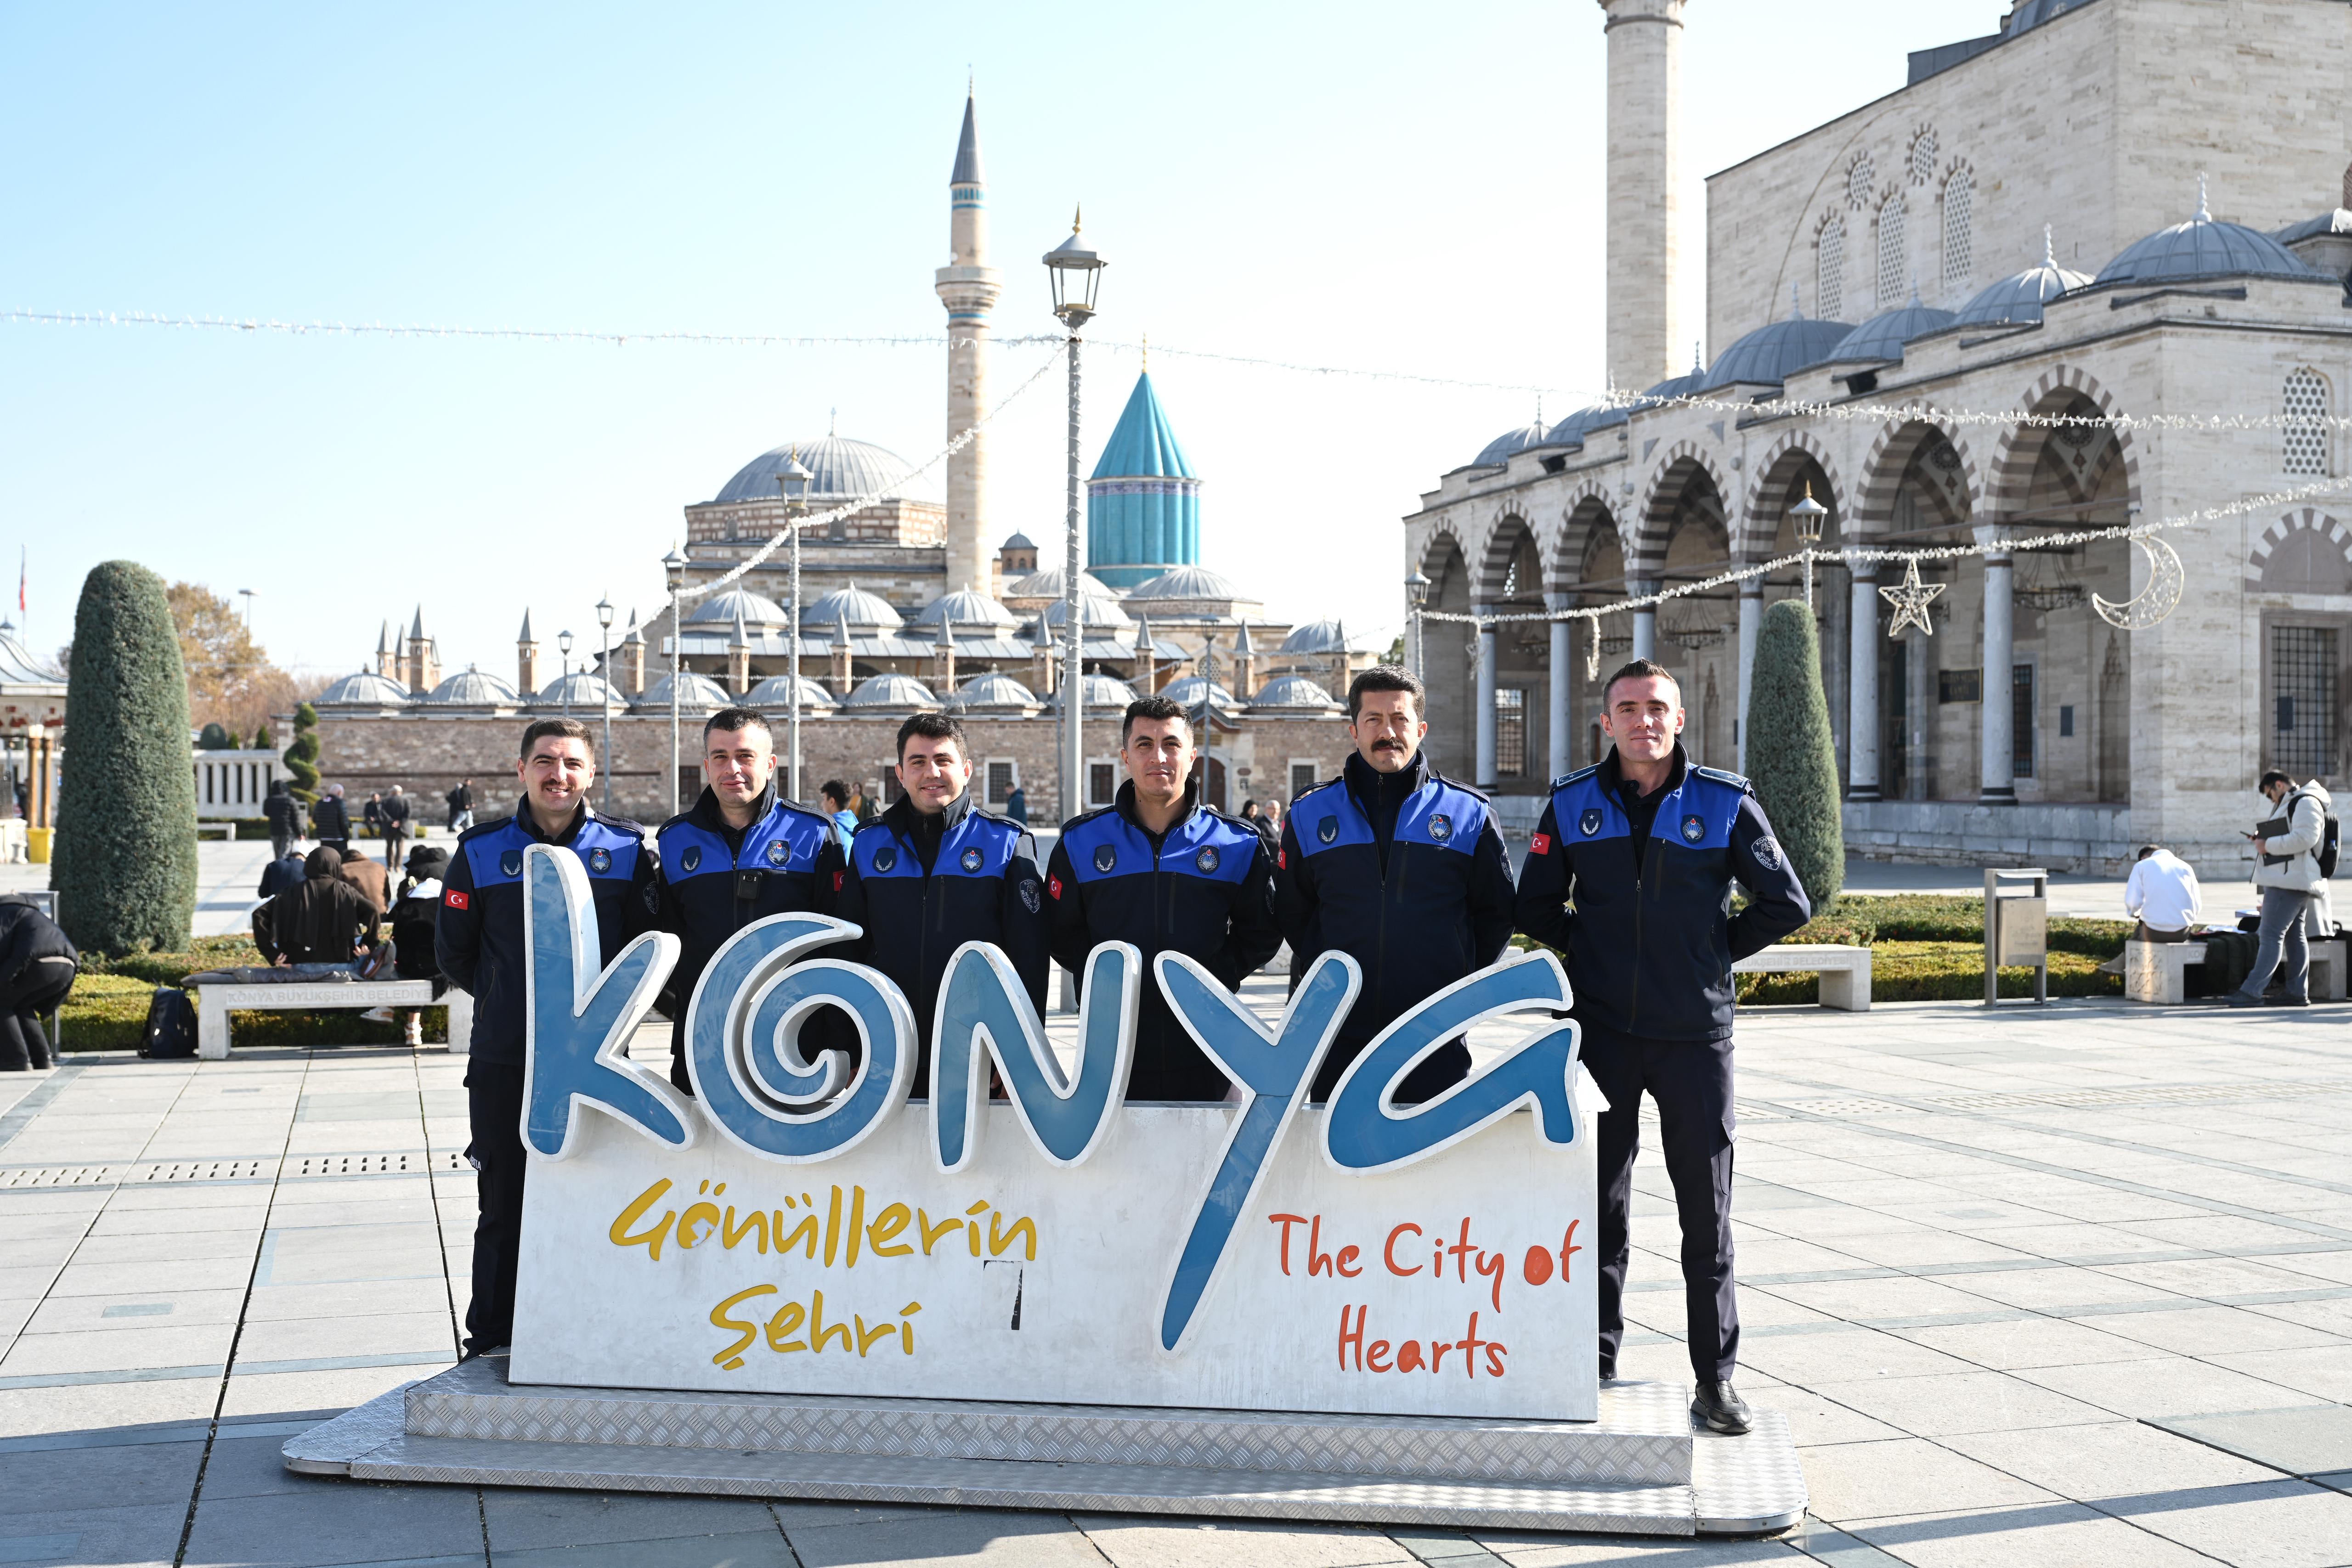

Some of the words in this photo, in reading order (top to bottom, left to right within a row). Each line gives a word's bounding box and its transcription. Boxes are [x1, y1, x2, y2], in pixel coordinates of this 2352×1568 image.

[1755, 837, 1772, 846] KONYA
[229, 990, 274, 1003] KONYA
[368, 986, 432, 1001] BELEDİYE
[1268, 1213, 1363, 1278] The
[1384, 1217, 1505, 1313] City
[1524, 1219, 1583, 1286] of
[1338, 1304, 1508, 1378] Hearts
